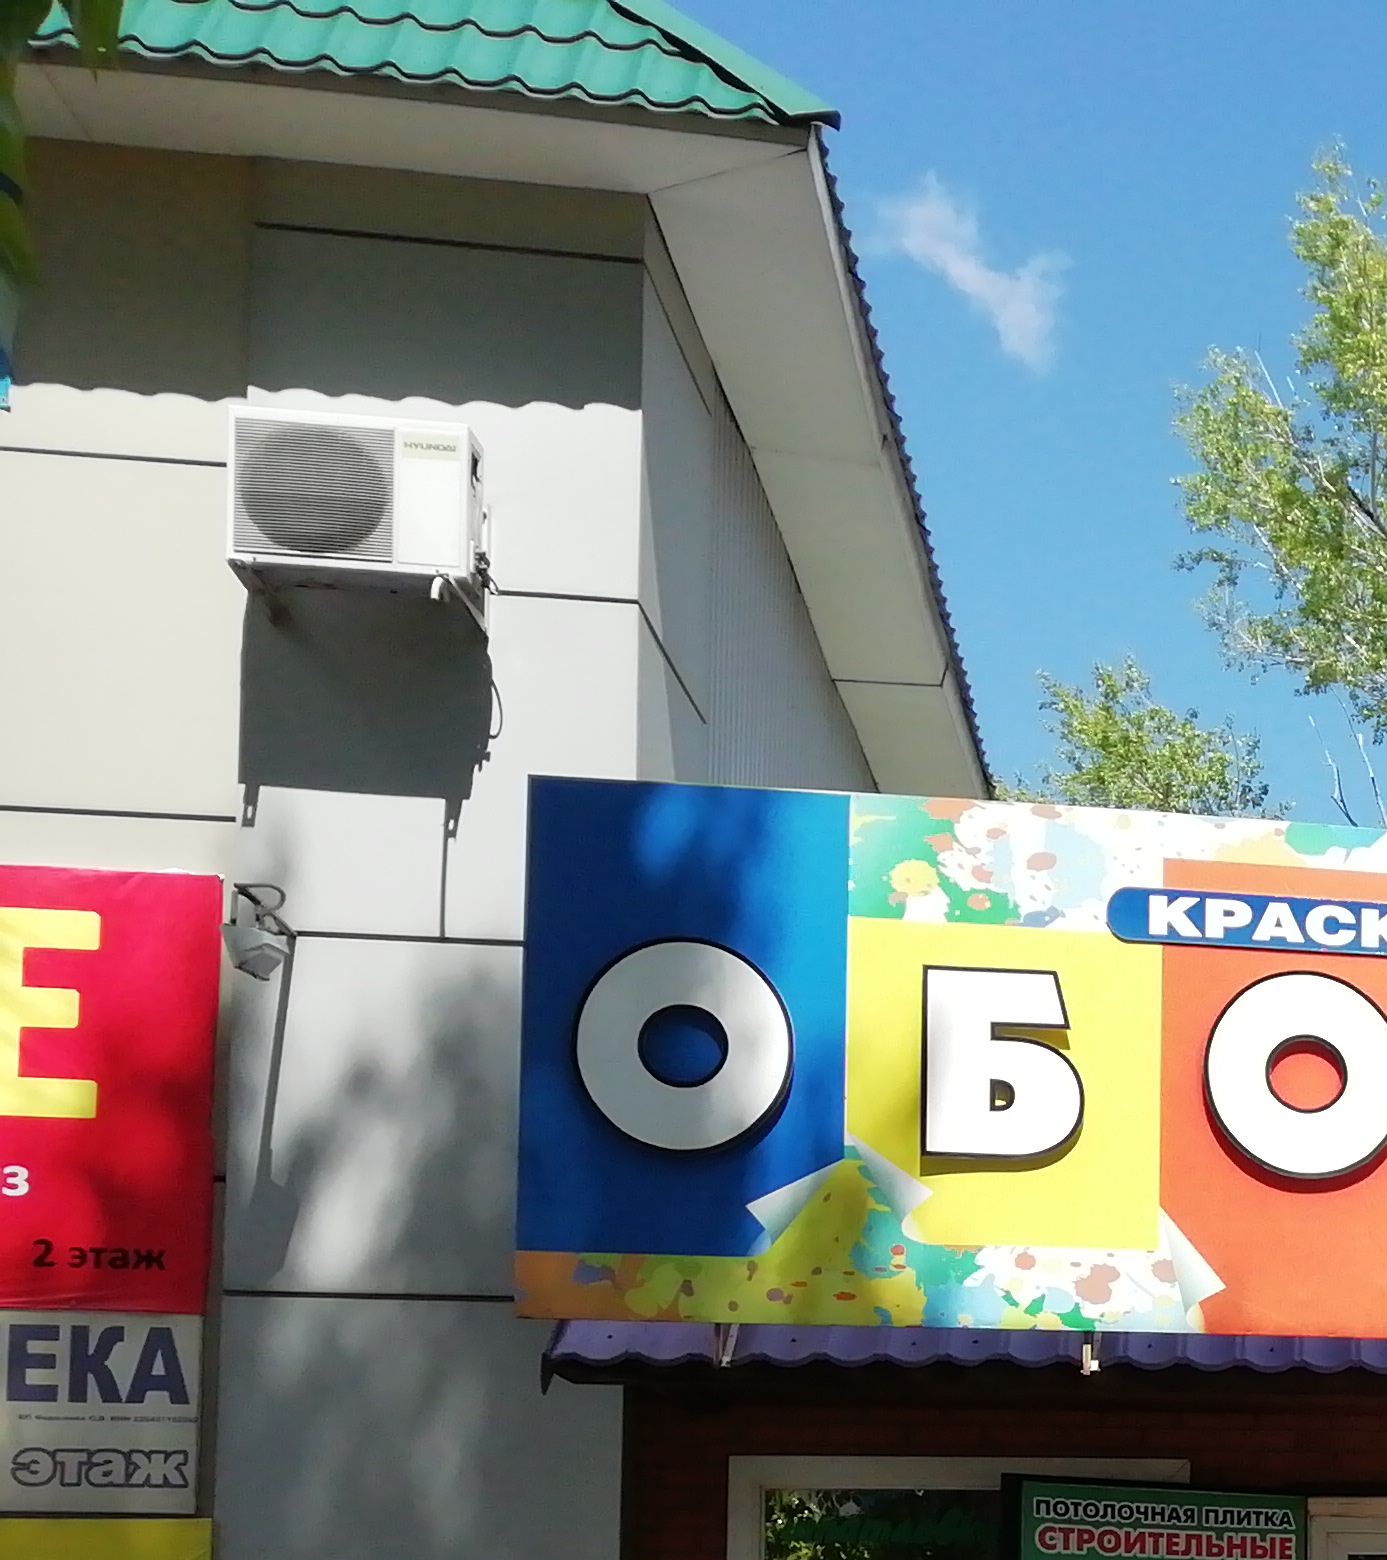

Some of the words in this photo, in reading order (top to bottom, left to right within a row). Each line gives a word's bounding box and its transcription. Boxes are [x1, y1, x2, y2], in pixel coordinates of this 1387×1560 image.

[33, 1239, 54, 1267] 2
[68, 1247, 166, 1270] этаж
[7, 1324, 190, 1404] ЕКА
[11, 1447, 189, 1488] этаж
[1035, 1499, 1196, 1524] ПОТОЛОЧНАЯ
[1204, 1508, 1295, 1528] ПЛИТКА
[1037, 1525, 1295, 1560] СТРОИТЕЛЬНЫЕ
